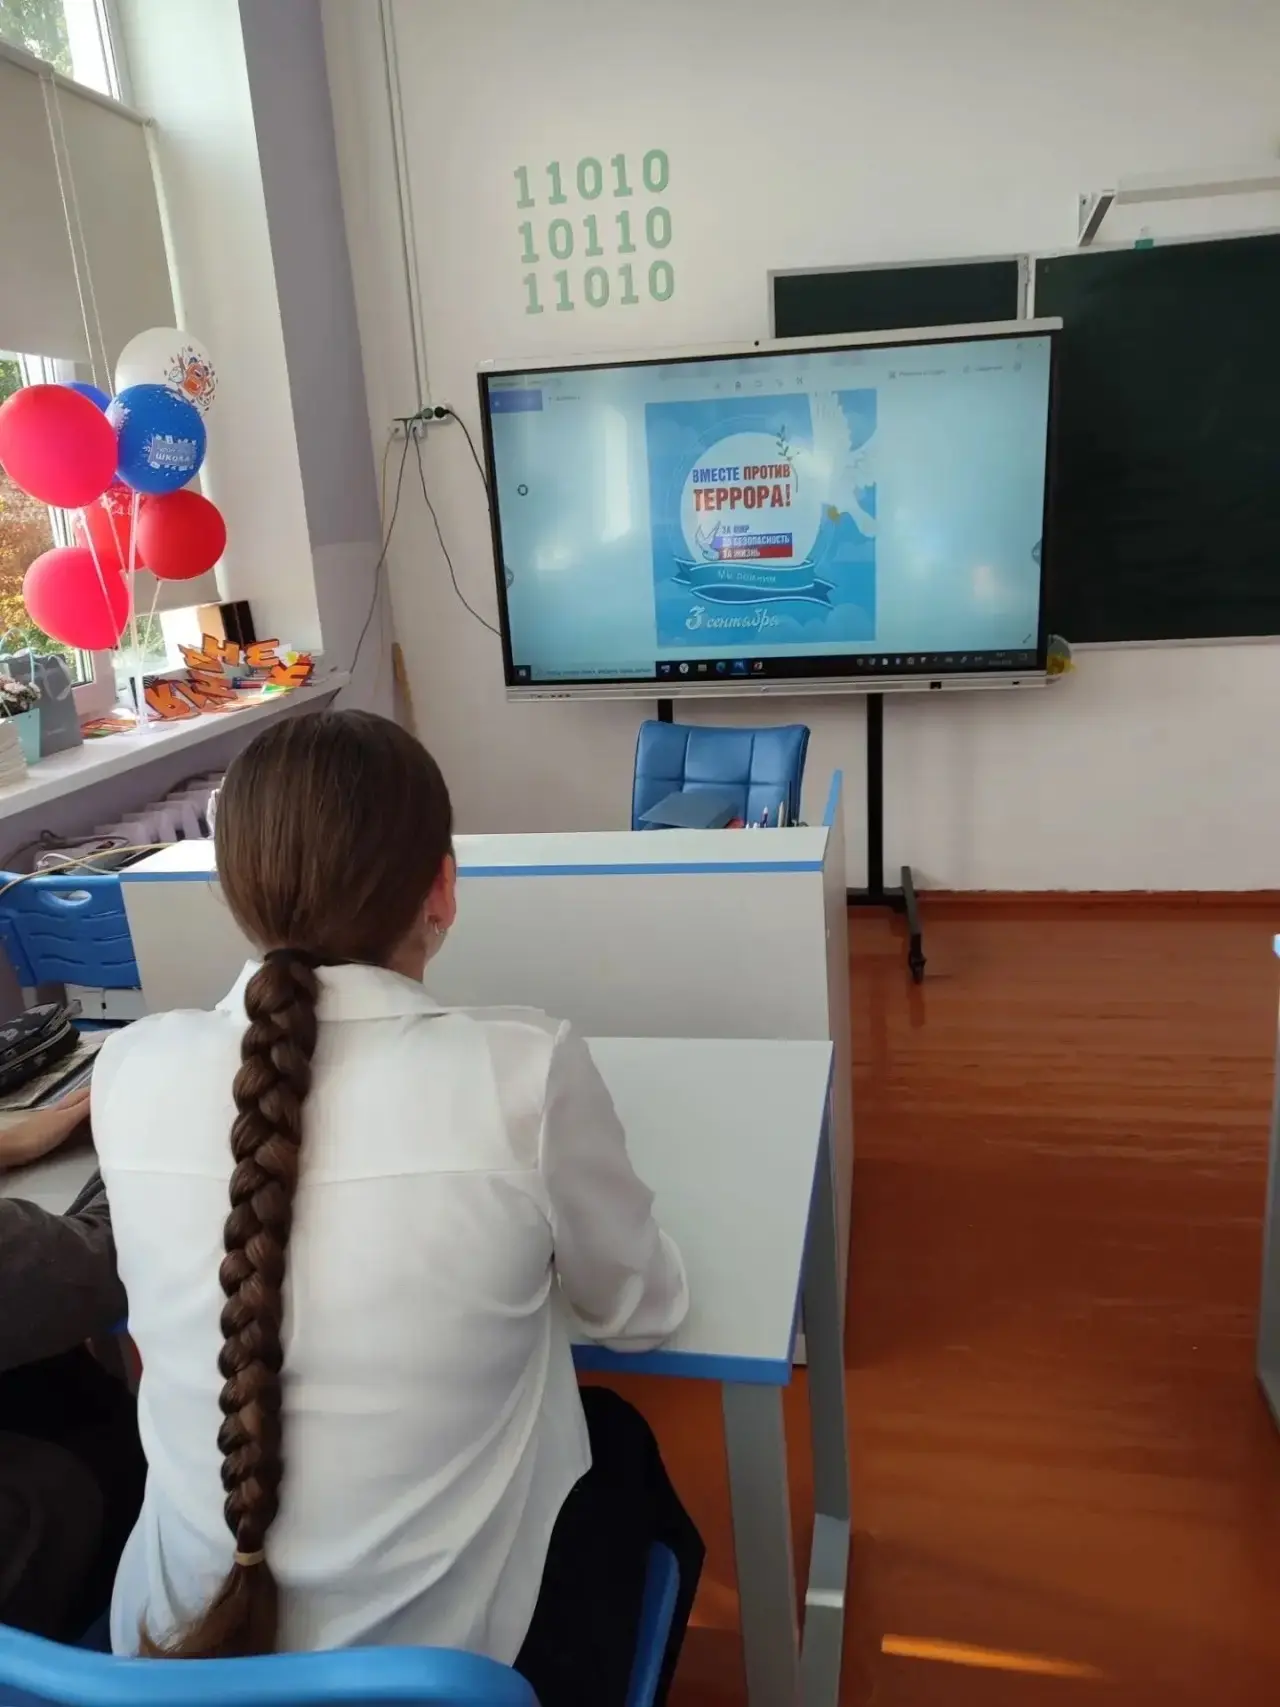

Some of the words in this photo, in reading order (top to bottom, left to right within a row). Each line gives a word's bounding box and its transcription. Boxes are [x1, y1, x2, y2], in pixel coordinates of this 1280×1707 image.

[514, 149, 669, 209] 11010
[518, 206, 672, 263] 10110
[523, 260, 674, 314] 11010
[692, 466, 740, 483] ВМЕСТЕ
[743, 463, 791, 480] ПРОТИВ
[693, 484, 791, 511] ТЕРРОРА!
[733, 534, 790, 546] БЕЗОПАСНОСТЬ
[685, 605, 705, 630] 3
[707, 608, 779, 632] сентября
